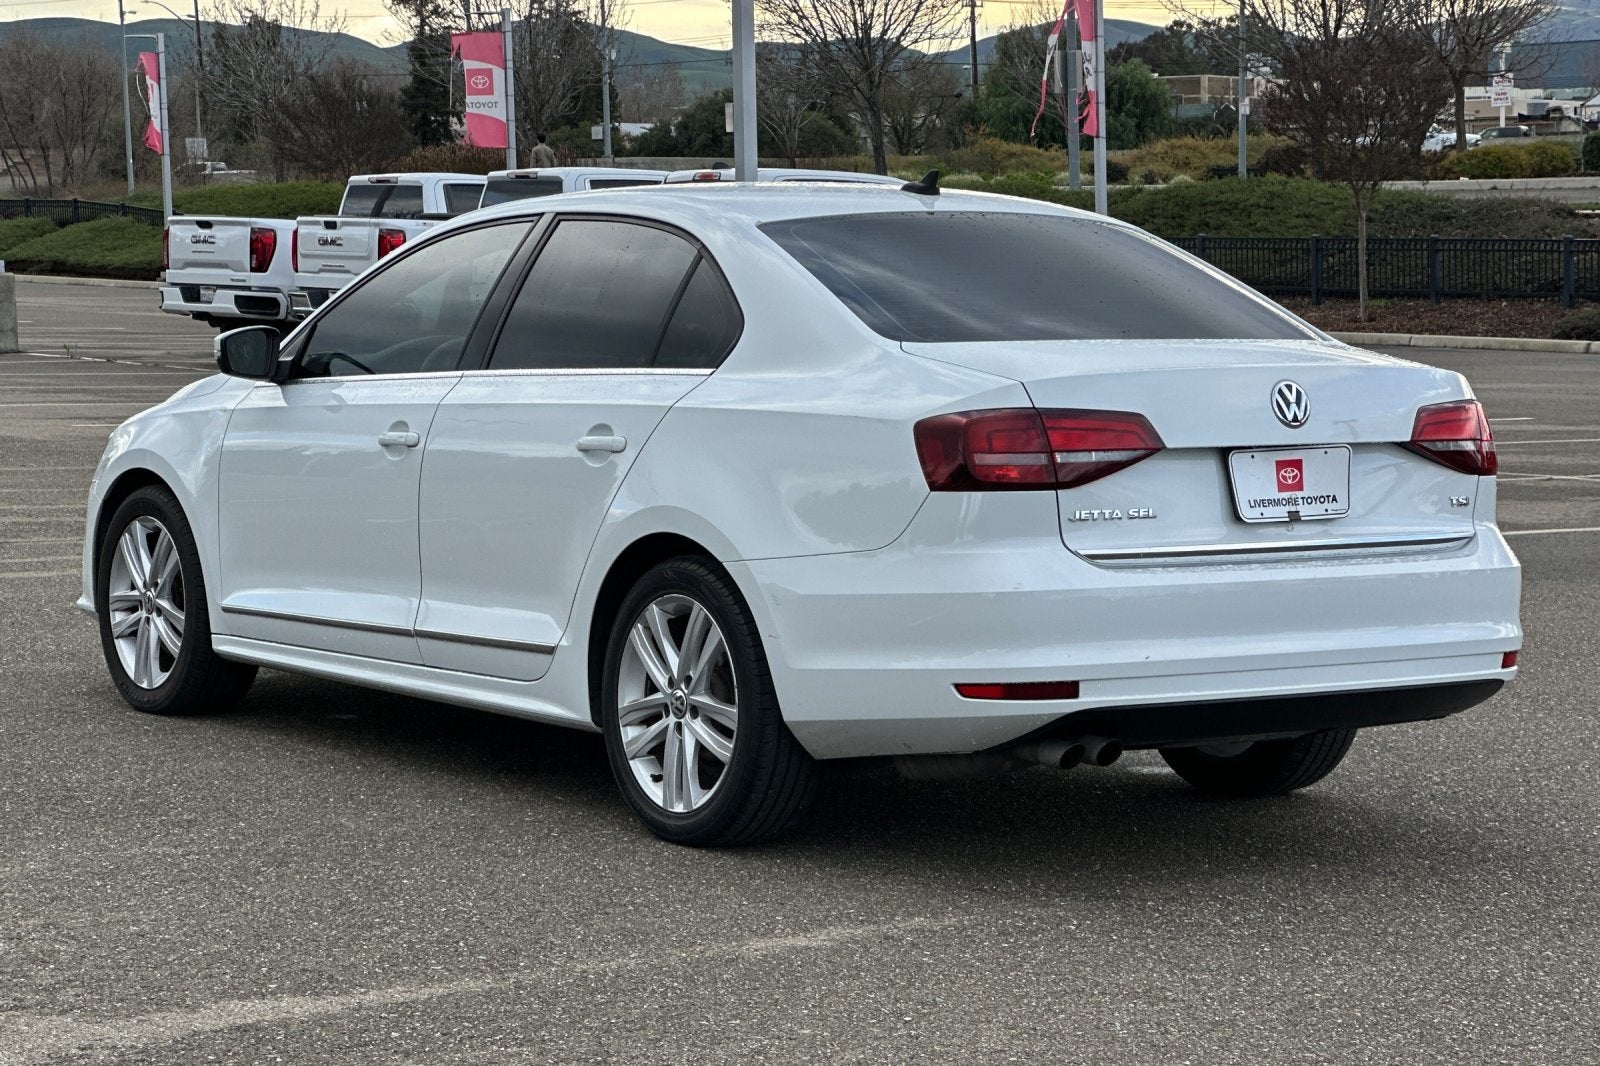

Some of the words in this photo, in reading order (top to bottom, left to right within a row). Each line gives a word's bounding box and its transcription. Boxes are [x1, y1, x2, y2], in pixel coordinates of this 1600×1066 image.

[190, 235, 216, 245] GMC
[317, 236, 344, 247] GMC
[1248, 497, 1300, 509] LIVERMORE
[1300, 494, 1339, 506] TOYOTA
[1068, 509, 1122, 522] JETTA
[1126, 507, 1157, 520] SEL
